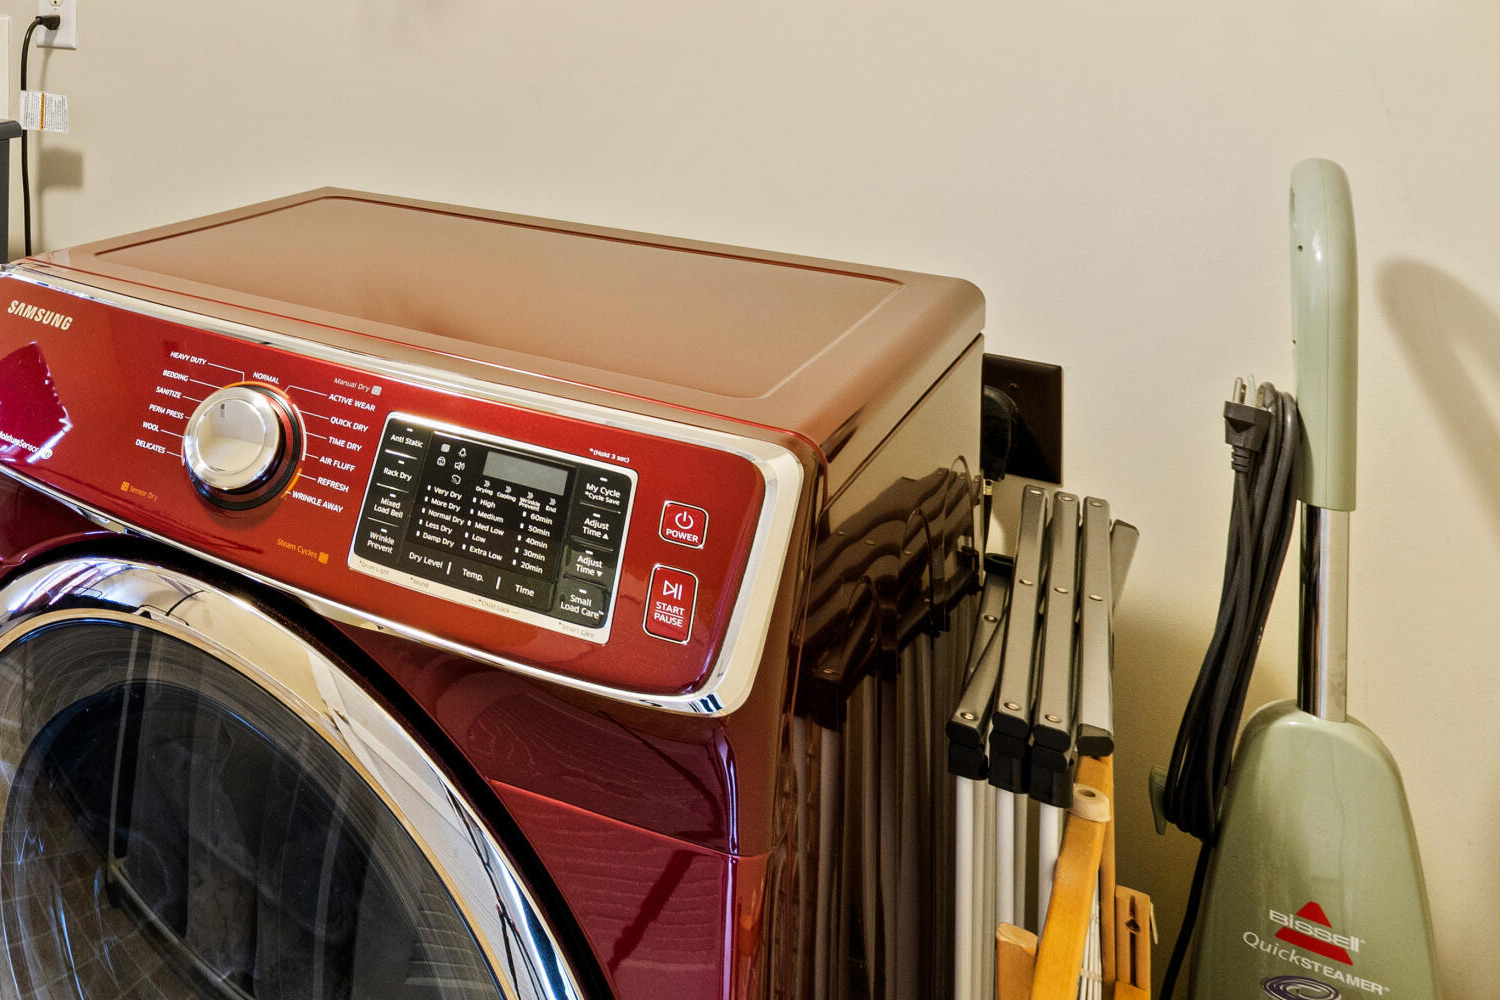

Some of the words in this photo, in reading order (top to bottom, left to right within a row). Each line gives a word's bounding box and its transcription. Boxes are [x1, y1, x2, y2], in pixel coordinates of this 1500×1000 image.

[7, 299, 73, 331] SAMSUNG
[170, 351, 189, 362] HEAVY
[190, 355, 207, 366] DUTY
[162, 369, 189, 382] BEDDING
[252, 371, 280, 384] NORMAL
[333, 377, 357, 390] Manual
[358, 383, 371, 393] Dry
[155, 386, 182, 399] SANITIZE
[328, 393, 353, 406] ACTIVE
[353, 399, 376, 412] WEAR
[149, 403, 167, 415] PERM
[166, 408, 184, 420] PRESS
[142, 421, 160, 433] WOOL
[330, 415, 352, 428] QUICK
[352, 421, 369, 433] DRY
[135, 438, 166, 454] DELICATES
[328, 436, 346, 447] TIME
[346, 441, 363, 452] DRY
[390, 434, 405, 443] Anti
[405, 438, 424, 448] Static
[319, 455, 333, 466] AIR
[333, 459, 356, 473] FLUFF
[383, 467, 399, 478] Rack
[399, 472, 413, 481] Dry
[317, 477, 350, 493] REFRESH
[475, 485, 494, 496] Drying
[586, 482, 599, 493] My
[600, 486, 621, 498] Cycle
[128, 485, 147, 498] Sensor
[147, 491, 159, 502] Dry
[433, 486, 449, 497] Very
[449, 490, 463, 501] Dry
[496, 491, 517, 502] Cooling
[292, 491, 322, 507] WRINKLE
[321, 499, 344, 513] AWAY
[380, 497, 401, 509] Mixed
[431, 497, 447, 508] More
[447, 502, 461, 512] Dry
[479, 498, 496, 509] High
[605, 497, 620, 506] Save
[373, 504, 390, 515] Load
[390, 508, 404, 519] Bell
[545, 505, 557, 513] End
[428, 509, 452, 521] Normal
[452, 515, 465, 526] Dry
[477, 510, 504, 523] Medium
[530, 513, 553, 525] 60min
[425, 520, 440, 531] Less
[440, 524, 453, 534] Dry
[474, 522, 489, 532] Med
[490, 526, 505, 536] Low
[527, 525, 551, 537] 50min
[584, 518, 610, 531] Adjust
[369, 531, 395, 545] Wrinkle
[471, 533, 487, 543] Low
[582, 526, 602, 538] Time
[665, 527, 699, 543] POWER
[367, 539, 393, 554] Prevent
[422, 532, 442, 543] Damp
[441, 537, 455, 548] Dry
[525, 537, 548, 549] 40min
[277, 538, 297, 552] Steam
[297, 544, 318, 559] Cycles
[469, 545, 488, 557] Extra
[488, 551, 503, 561] Low
[522, 549, 546, 561] 30min
[408, 551, 423, 563] Dry
[423, 556, 444, 569] Level
[577, 555, 603, 568] Adjust
[462, 567, 484, 582] Temp.
[520, 561, 543, 574] 20min
[575, 564, 596, 576] Time
[515, 583, 535, 597] Time
[560, 601, 580, 613] Load
[569, 594, 592, 607] Small
[655, 601, 685, 616] START
[653, 612, 684, 628] PAUSE
